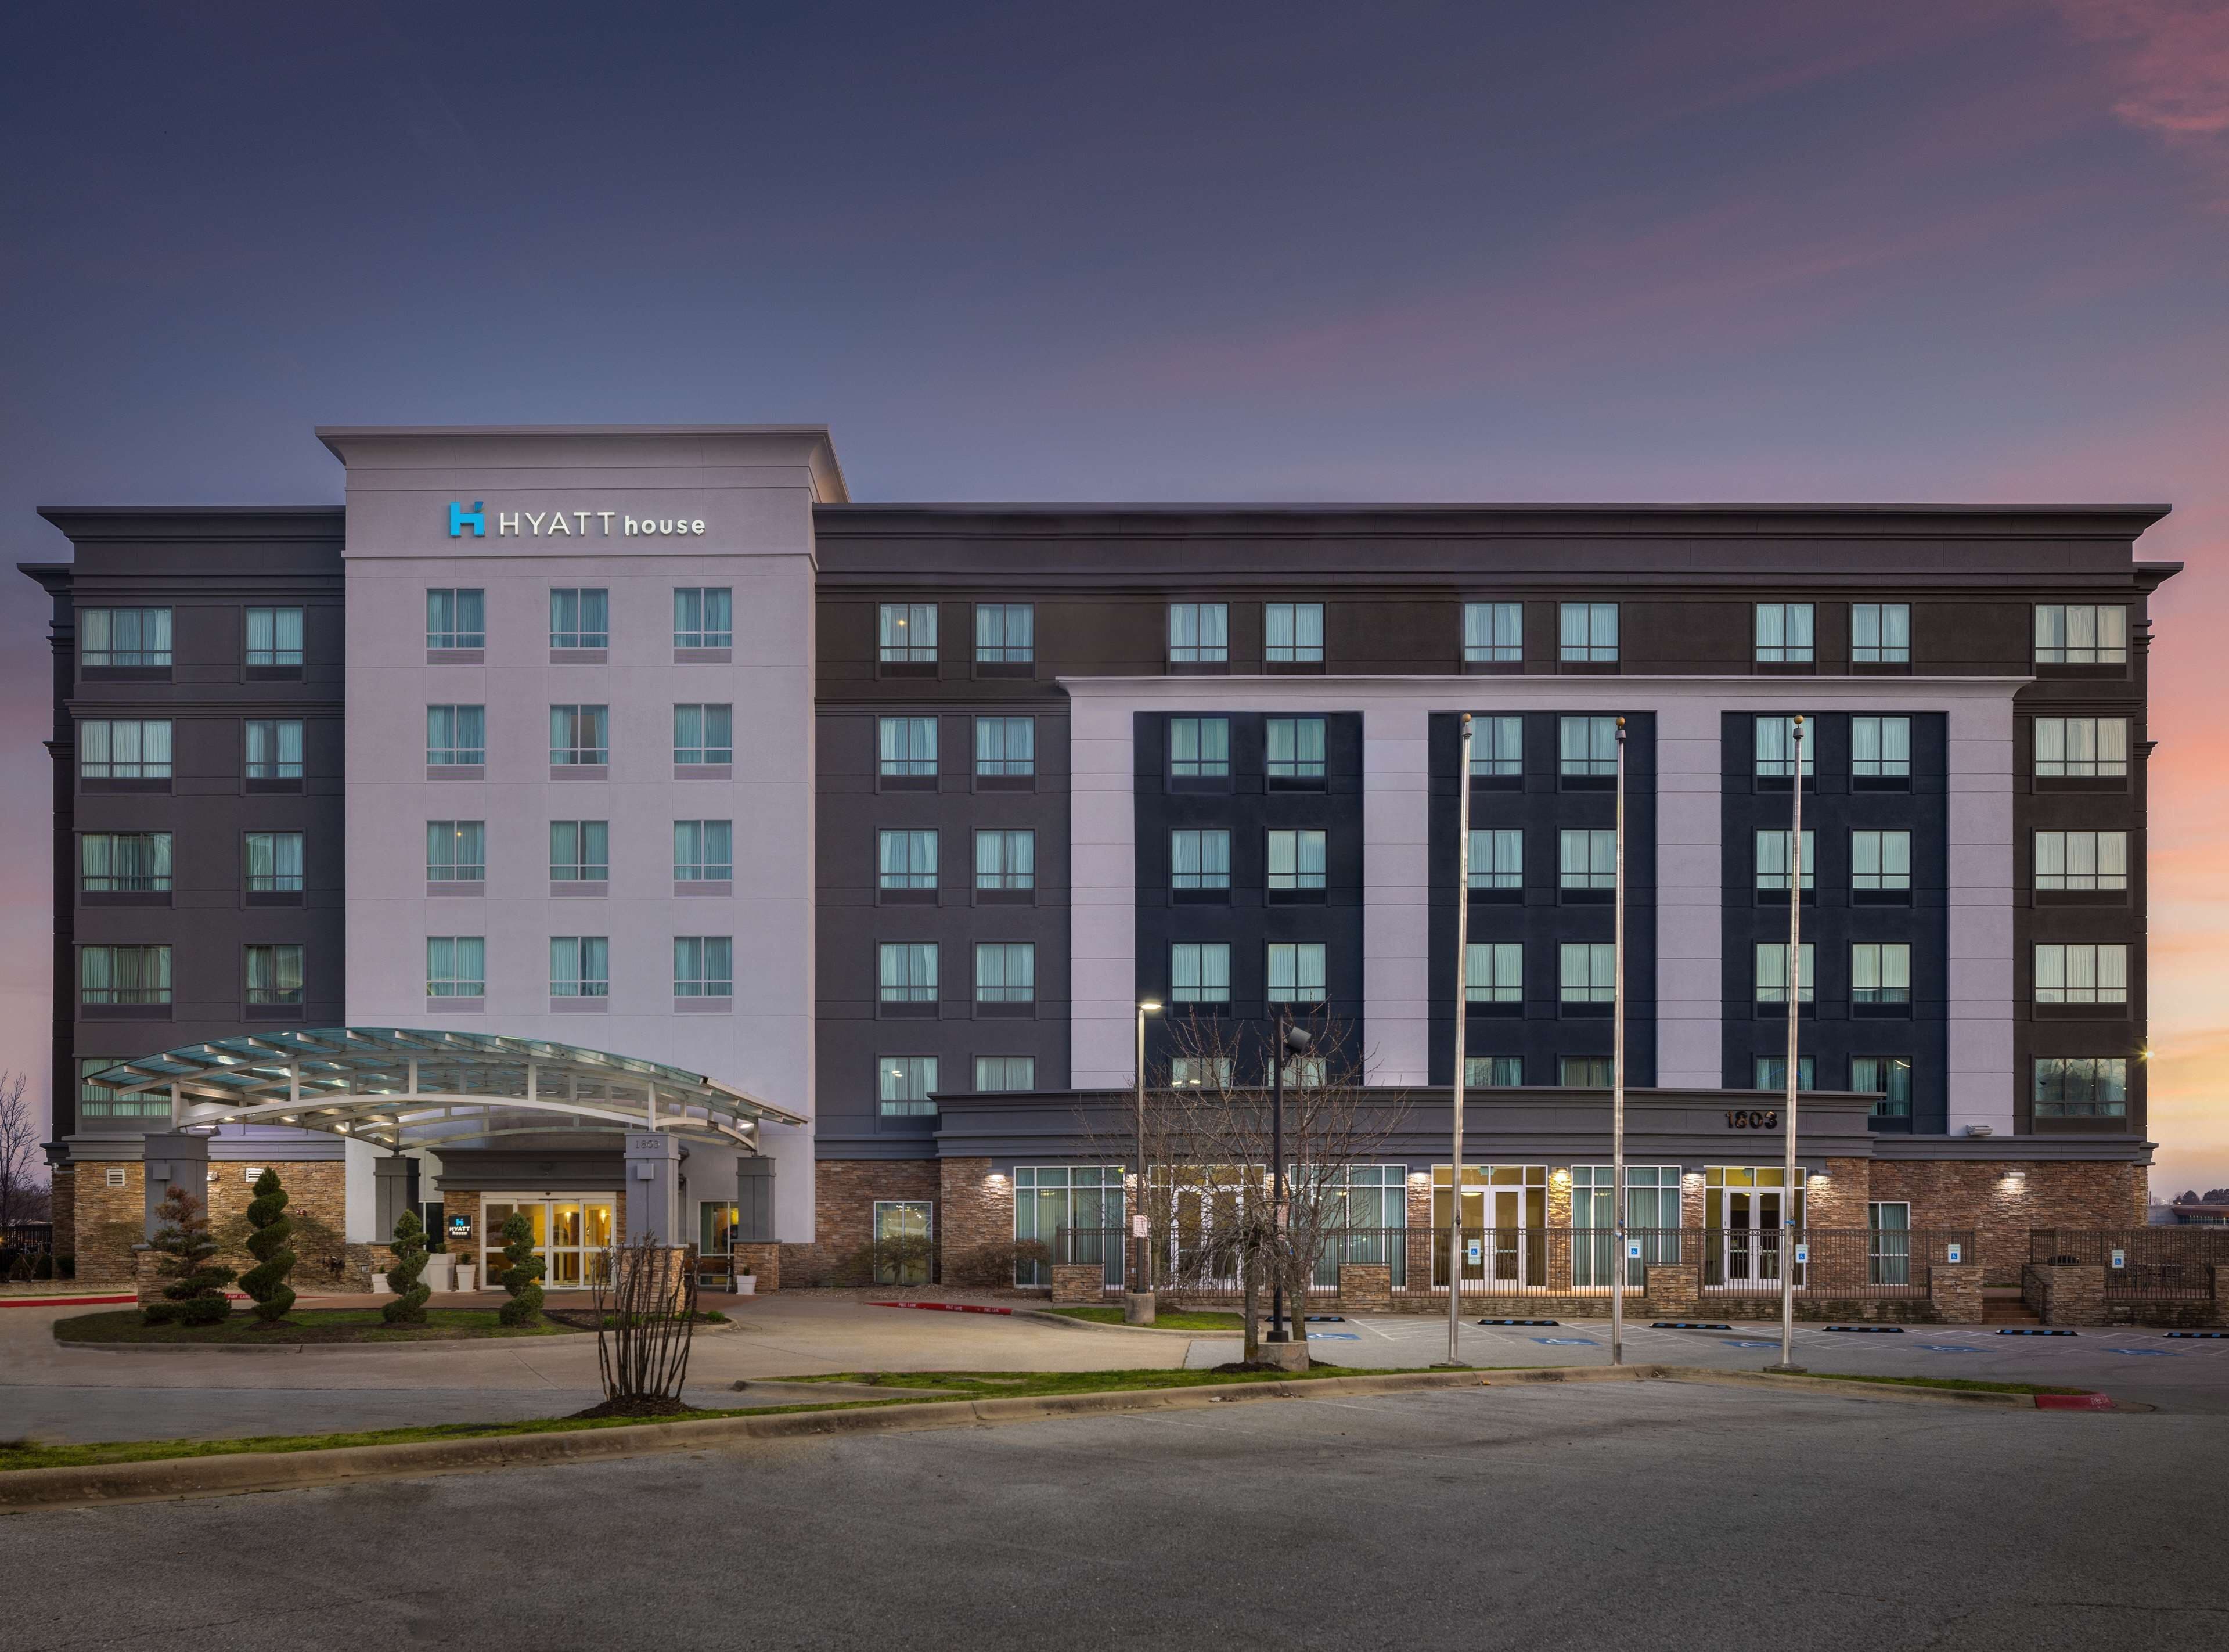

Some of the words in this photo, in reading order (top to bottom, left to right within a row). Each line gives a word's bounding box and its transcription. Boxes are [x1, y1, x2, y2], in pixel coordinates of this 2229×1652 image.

[500, 512, 615, 537] HYATT
[625, 515, 705, 535] house
[1725, 1110, 1778, 1129] 1803
